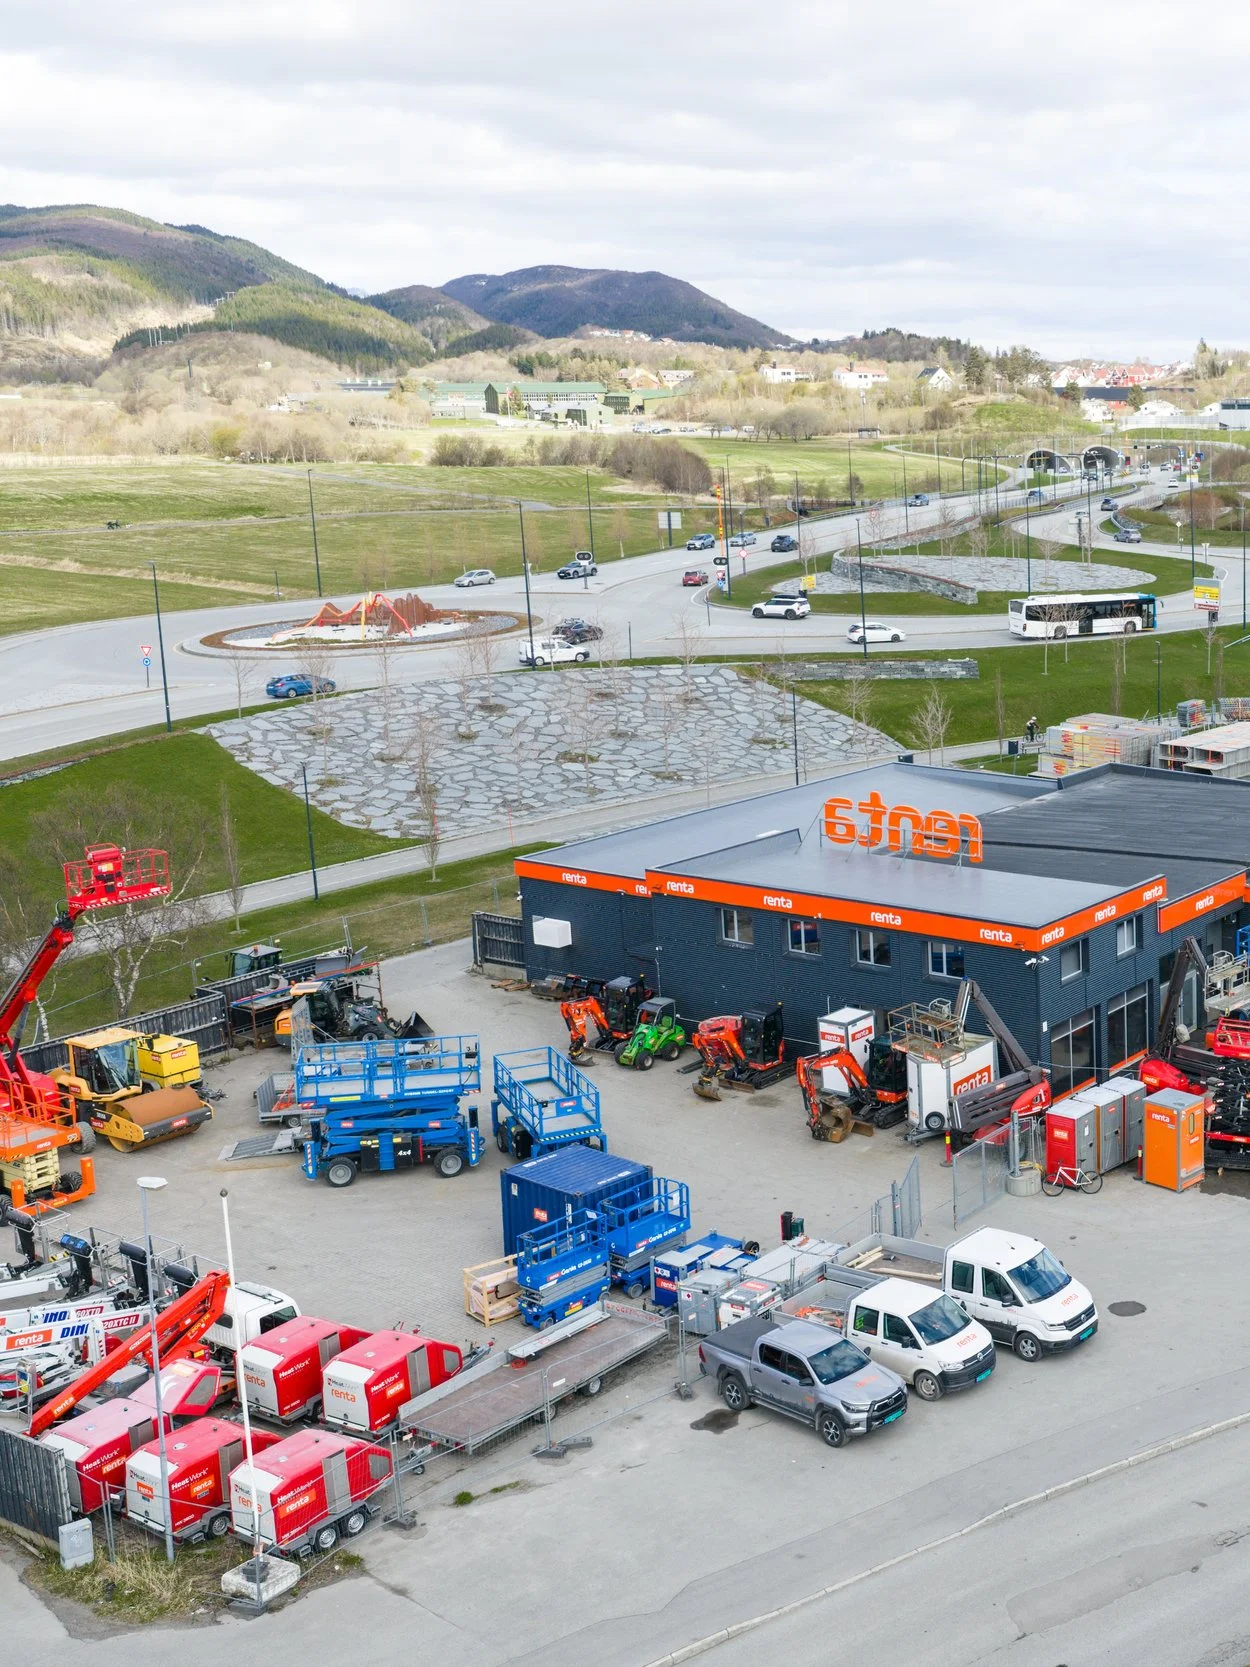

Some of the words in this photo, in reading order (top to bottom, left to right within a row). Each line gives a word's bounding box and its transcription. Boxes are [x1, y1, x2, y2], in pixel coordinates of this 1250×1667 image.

[562, 872, 587, 885] renta
[666, 881, 694, 894] renta
[1143, 883, 1163, 902] renta
[763, 895, 792, 909] renta
[1196, 894, 1214, 911] renta
[870, 911, 902, 925] renta
[1094, 904, 1116, 922] renta
[979, 928, 1012, 942] renta
[1041, 926, 1064, 945] renta
[825, 1034, 841, 1042] renta
[854, 1028, 869, 1040] renta
[955, 1071, 989, 1095] renta
[1152, 1112, 1170, 1123] renta
[1061, 1292, 1079, 1308] renta
[43, 1311, 67, 1323] INO
[103, 1318, 129, 1329] 20XTC
[60, 1323, 89, 1338] DIN
[15, 1334, 43, 1346] renta
[956, 1333, 977, 1348] renta
[331, 1388, 356, 1403] renta
[193, 1479, 213, 1493] renta
[238, 1496, 262, 1513] rena
[286, 1495, 310, 1513] renta
